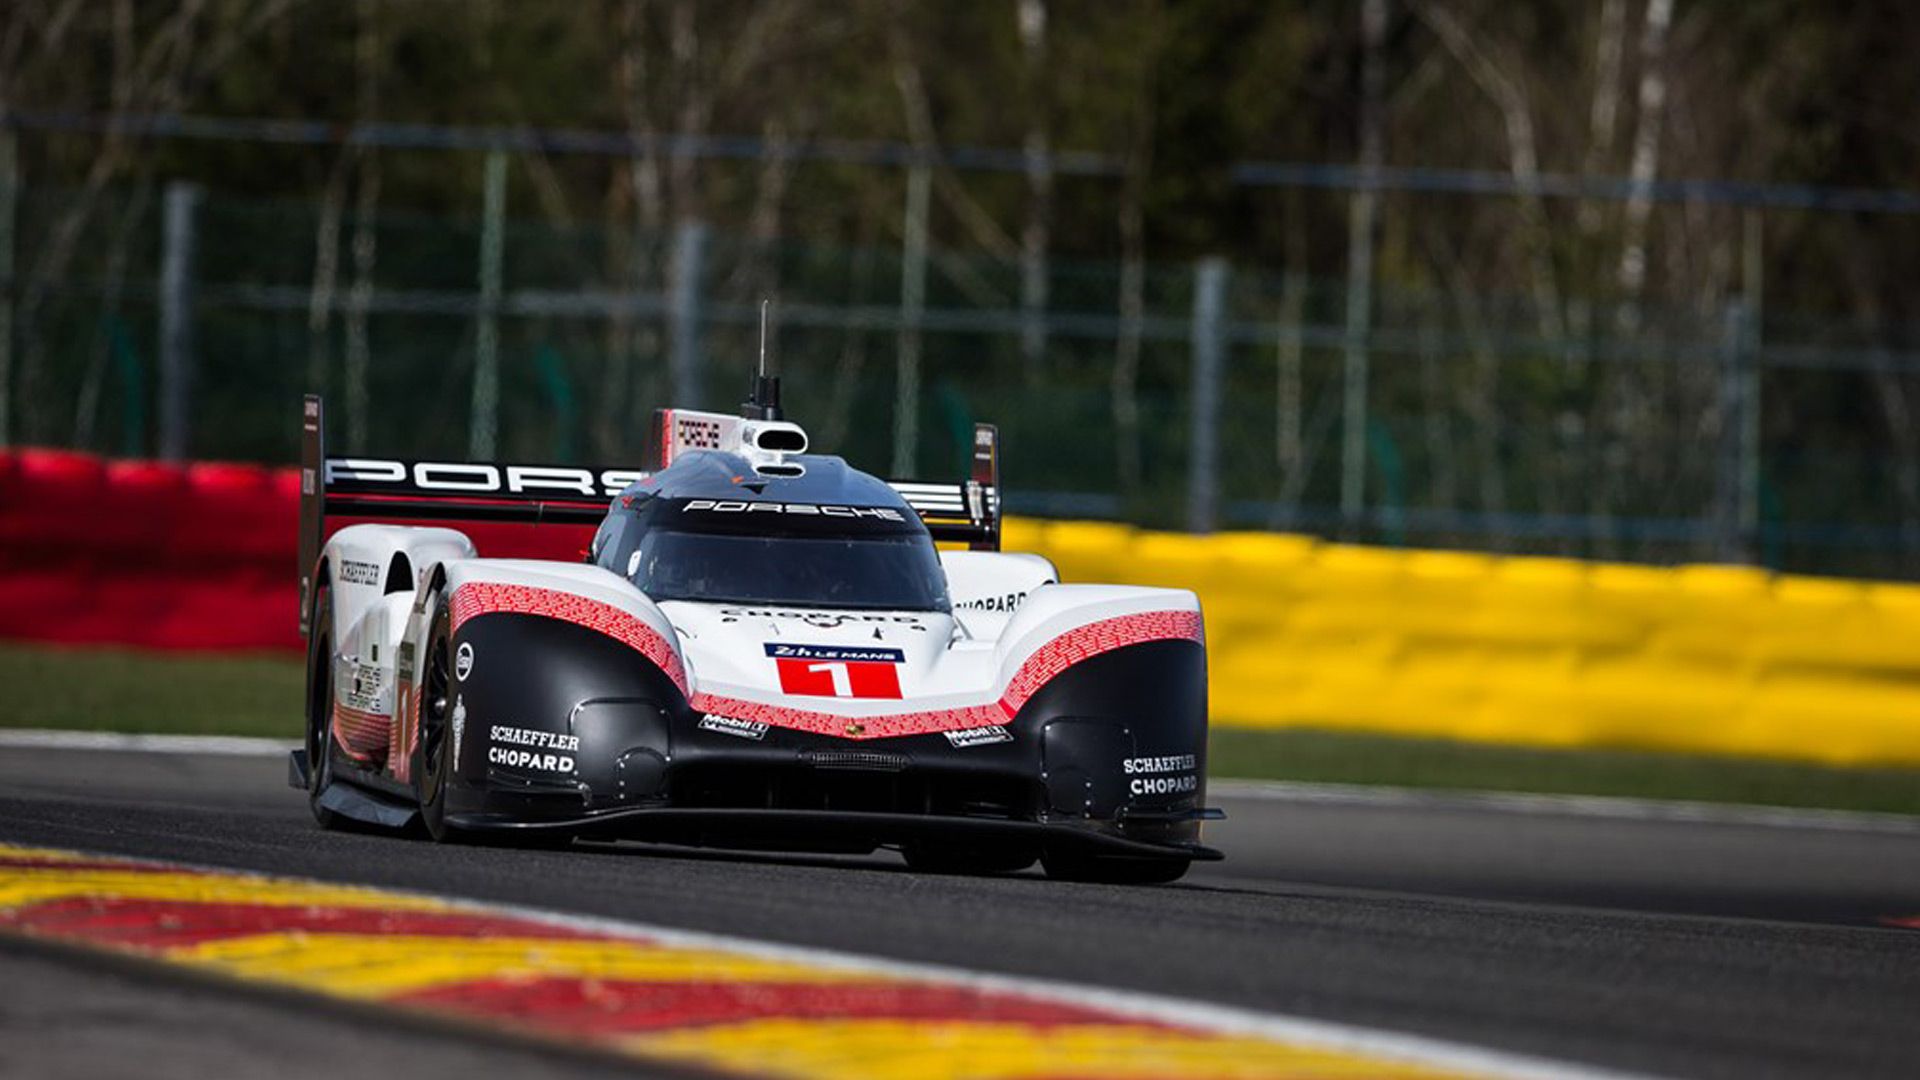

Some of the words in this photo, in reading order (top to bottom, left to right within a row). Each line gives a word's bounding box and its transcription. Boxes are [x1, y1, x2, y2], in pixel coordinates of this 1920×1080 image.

[682, 500, 906, 523] PORSCHE
[814, 650, 837, 659] LE
[841, 652, 897, 661] MANS
[808, 662, 854, 698] 1
[703, 713, 753, 730] Mobil
[490, 725, 580, 752] SCHAEFFLER
[488, 747, 575, 773] CHOPARD
[1130, 775, 1197, 794] CHOPARD
